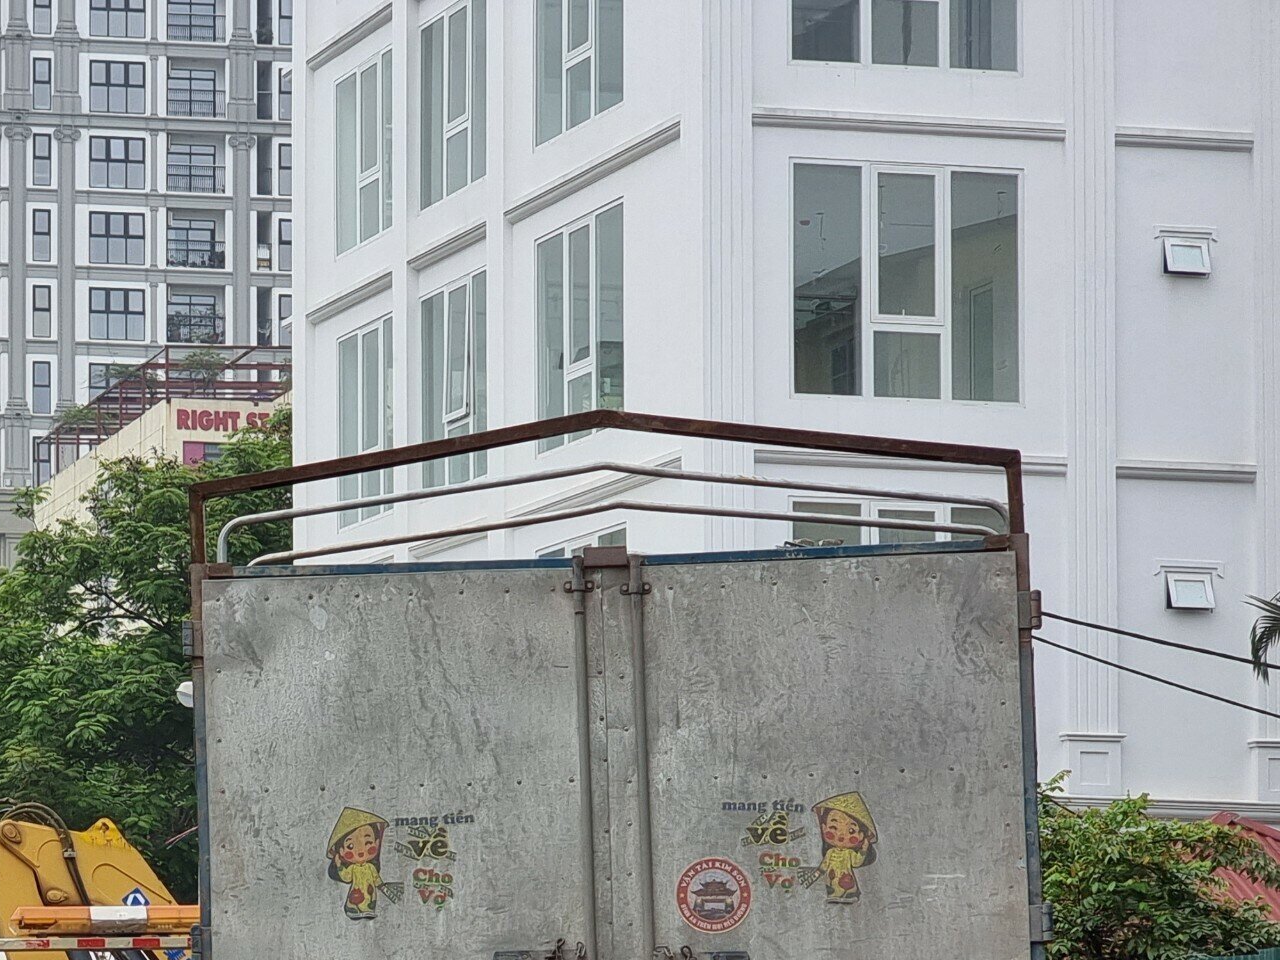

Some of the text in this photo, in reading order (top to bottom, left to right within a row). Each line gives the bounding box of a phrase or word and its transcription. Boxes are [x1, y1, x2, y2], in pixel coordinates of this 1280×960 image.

[176, 408, 240, 432] RIGHT
[721, 800, 768, 812] mang
[394, 815, 439, 828] mang
[714, 861, 732, 872] KIM
[758, 851, 801, 868] Cho
[412, 868, 454, 885] Cho
